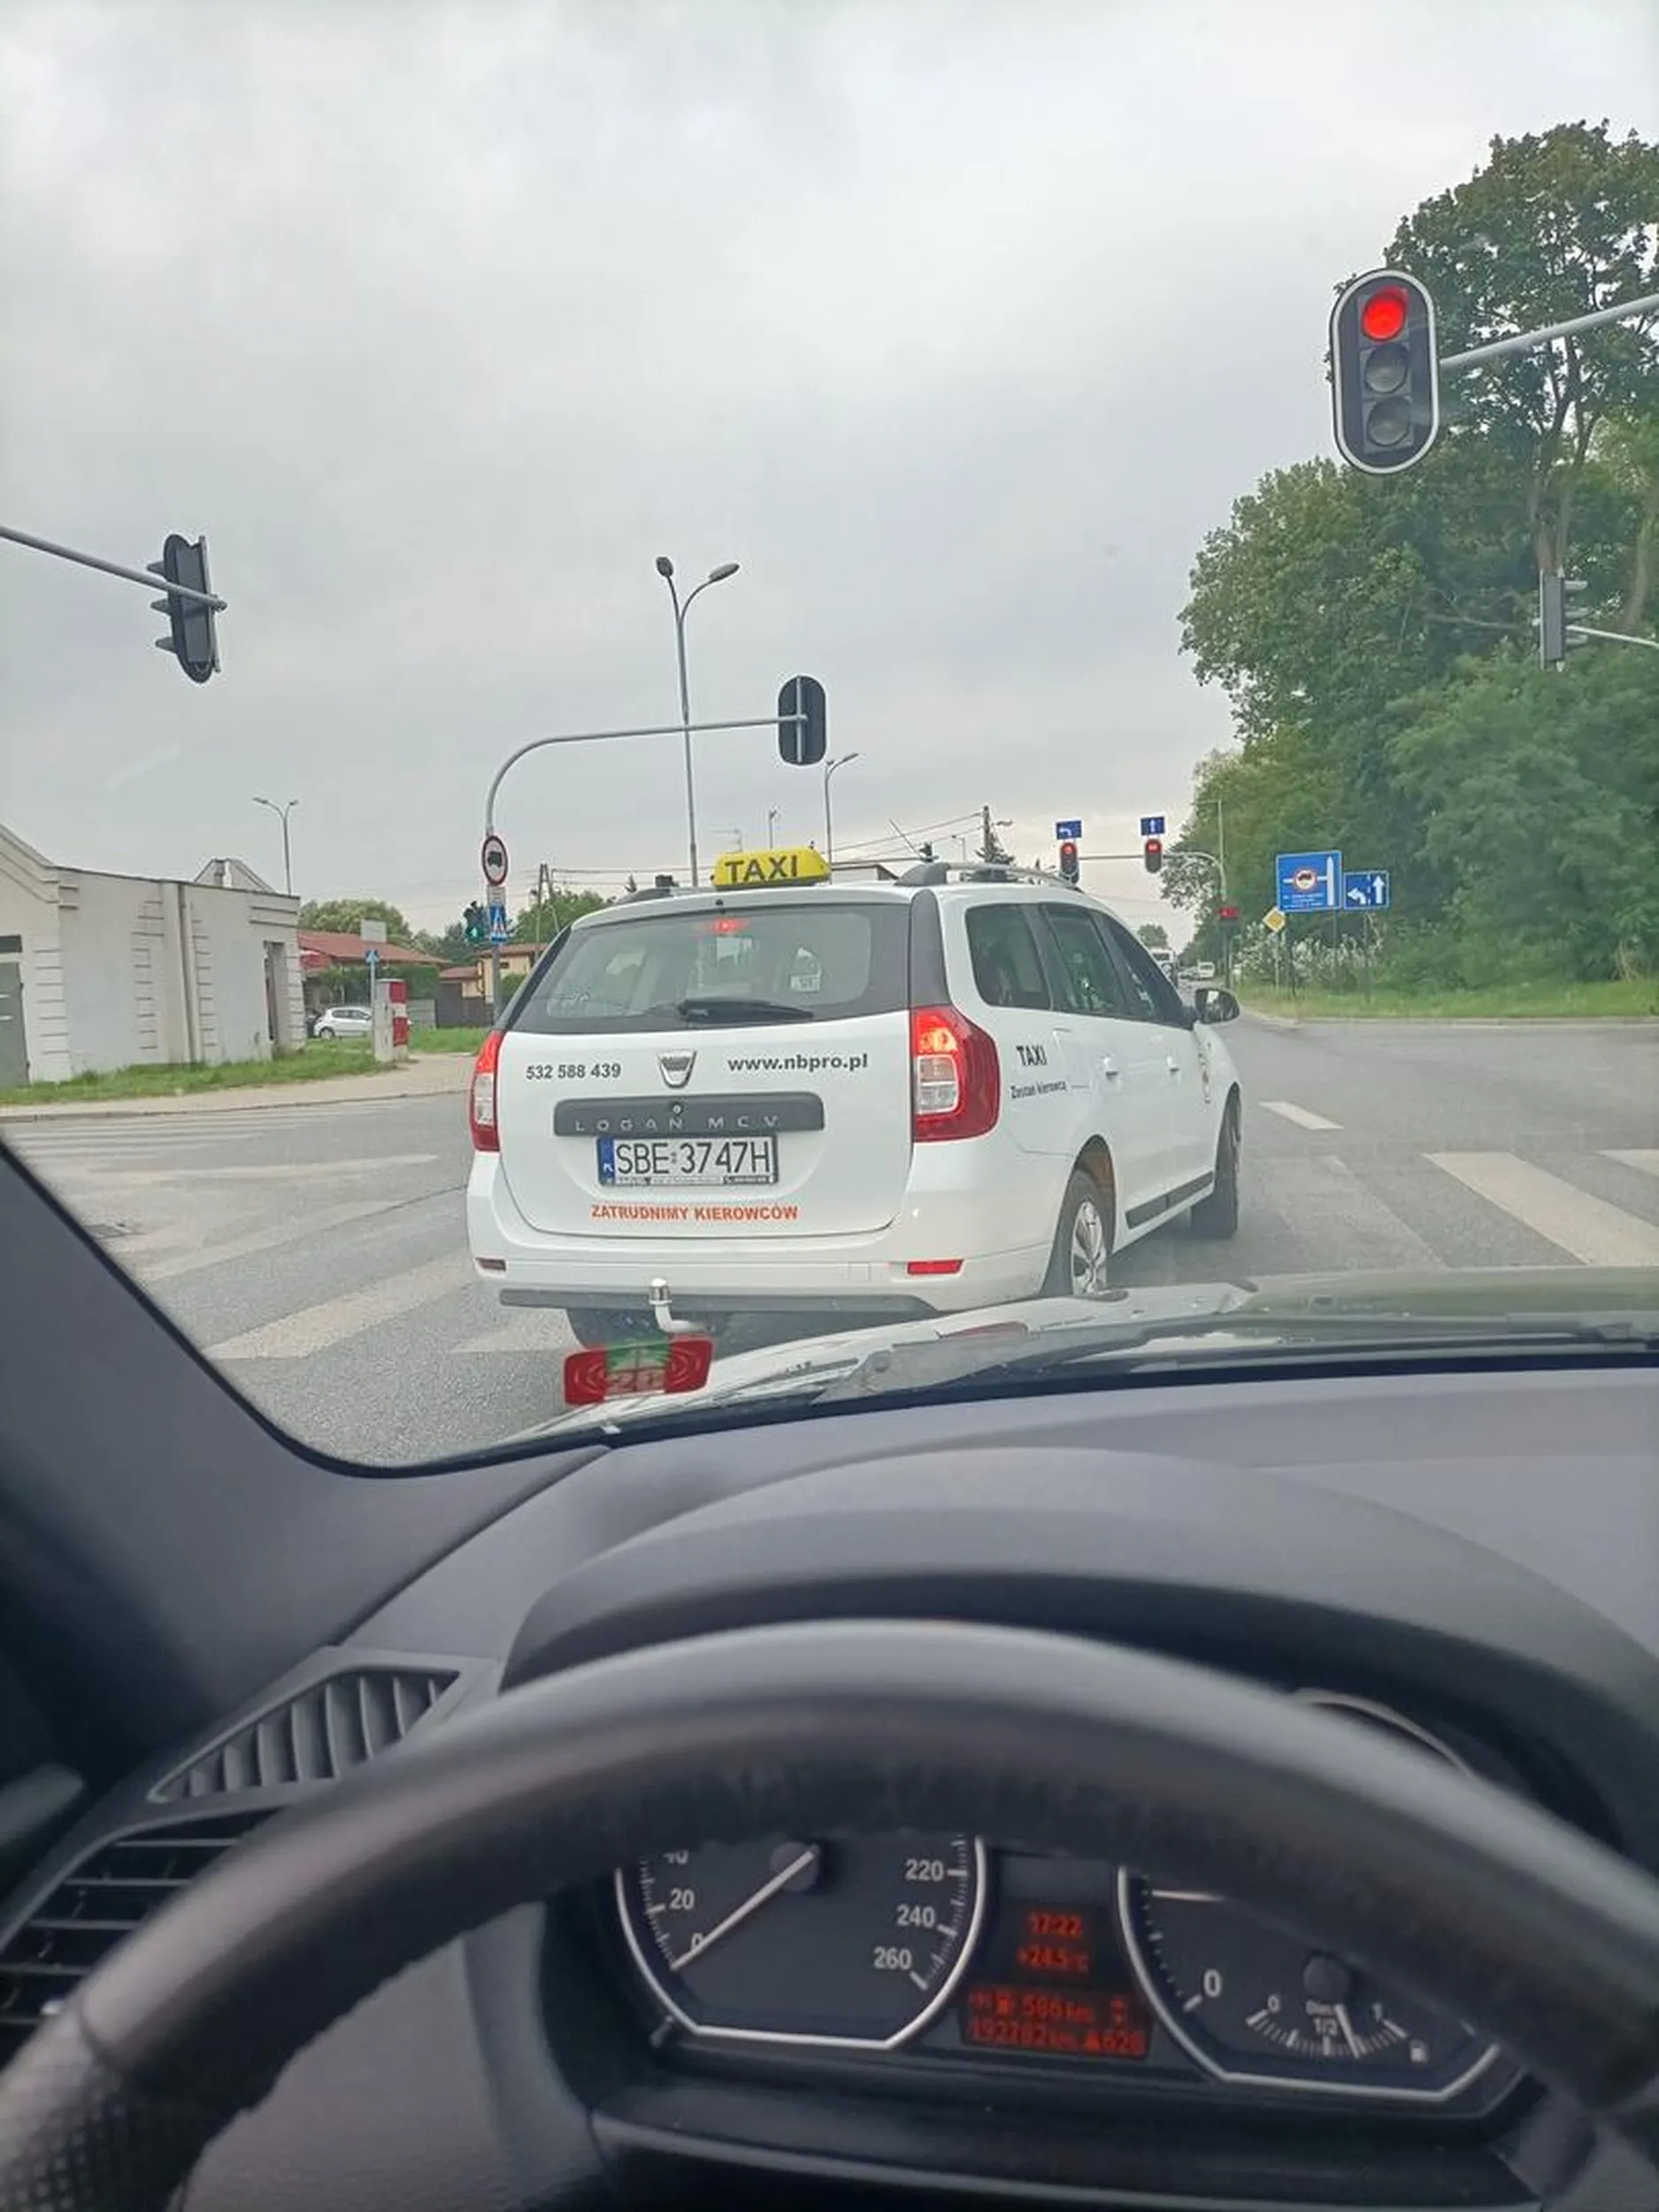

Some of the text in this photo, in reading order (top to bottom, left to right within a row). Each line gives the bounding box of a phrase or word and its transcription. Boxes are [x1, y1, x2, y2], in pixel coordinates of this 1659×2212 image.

[725, 854, 798, 883] TAXI
[727, 1053, 868, 1072] www.nbpro.pl
[1016, 1045, 1047, 1066] TAXI
[526, 1063, 621, 1079] 532 588 439
[575, 1115, 779, 1132] LOGAN MCV
[616, 1142, 670, 1174] SBE
[679, 1141, 771, 1174] 3747H
[591, 1204, 798, 1221] ZATRUDNIMY KIEROWCÓW
[904, 1859, 944, 1882] 220
[670, 1888, 695, 1910] 20
[896, 1904, 936, 1928] 240
[873, 1947, 912, 1970] 260
[1204, 1969, 1222, 1997] 0
[1268, 1995, 1280, 2013] 0
